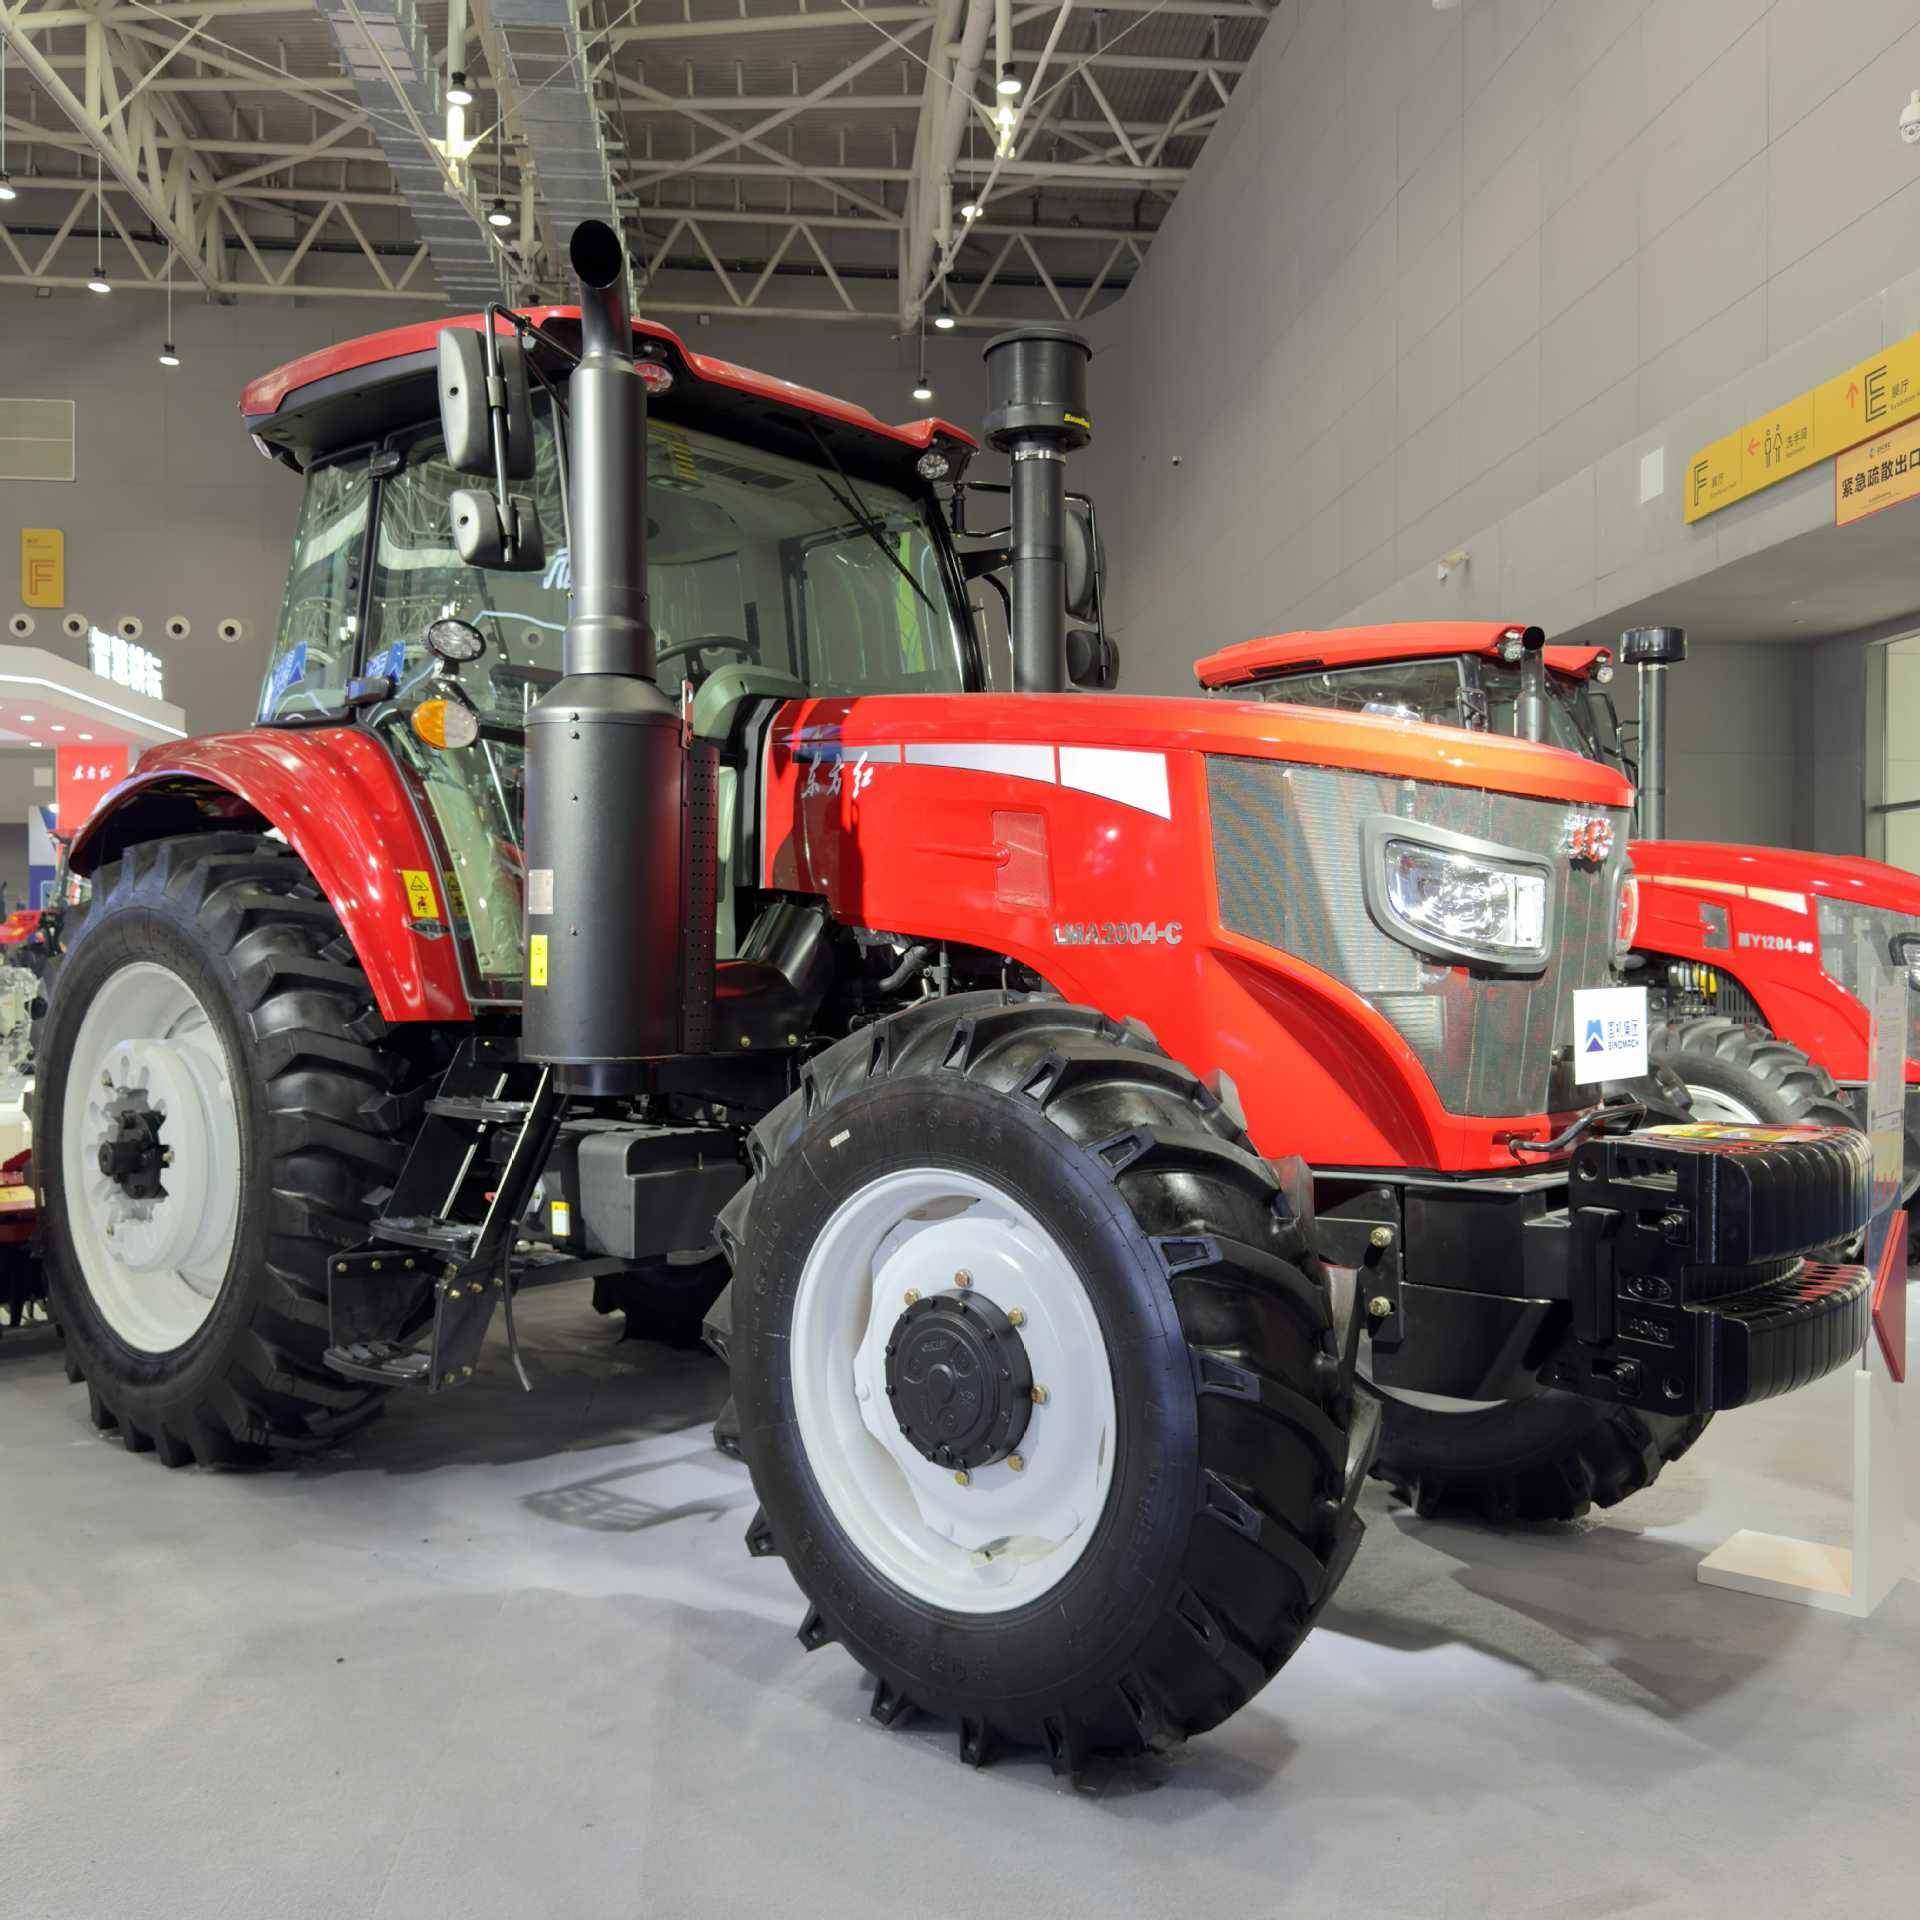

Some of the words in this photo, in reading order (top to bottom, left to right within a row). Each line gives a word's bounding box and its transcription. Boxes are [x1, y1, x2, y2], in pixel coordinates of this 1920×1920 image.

[1864, 364, 1887, 423] E
[1693, 459, 1709, 507] F
[1841, 447, 1920, 500] 紧急疏散出口
[29, 560, 55, 596] F
